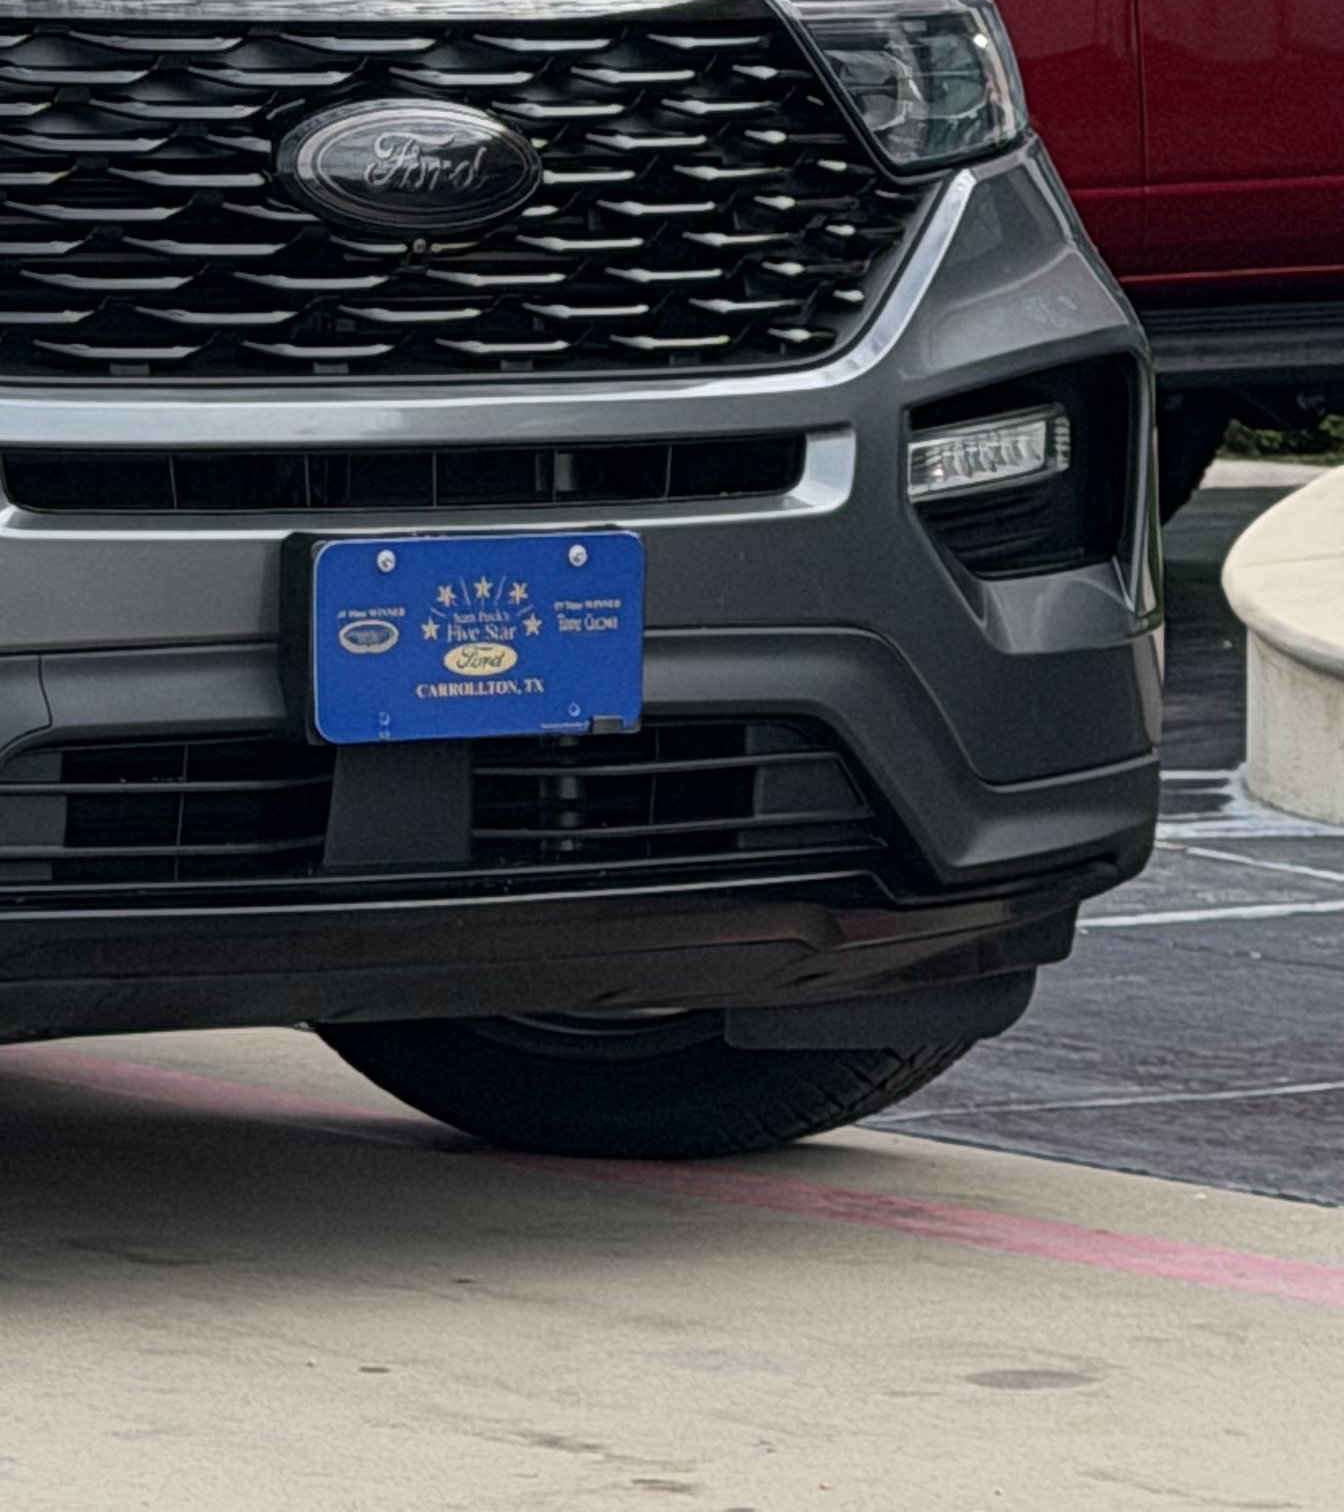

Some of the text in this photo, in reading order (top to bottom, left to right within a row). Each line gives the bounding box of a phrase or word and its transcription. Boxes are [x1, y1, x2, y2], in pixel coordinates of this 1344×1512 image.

[365, 131, 489, 191] Ford
[446, 622, 517, 642] Five Star
[456, 646, 506, 669] Ford
[523, 678, 544, 693] TX
